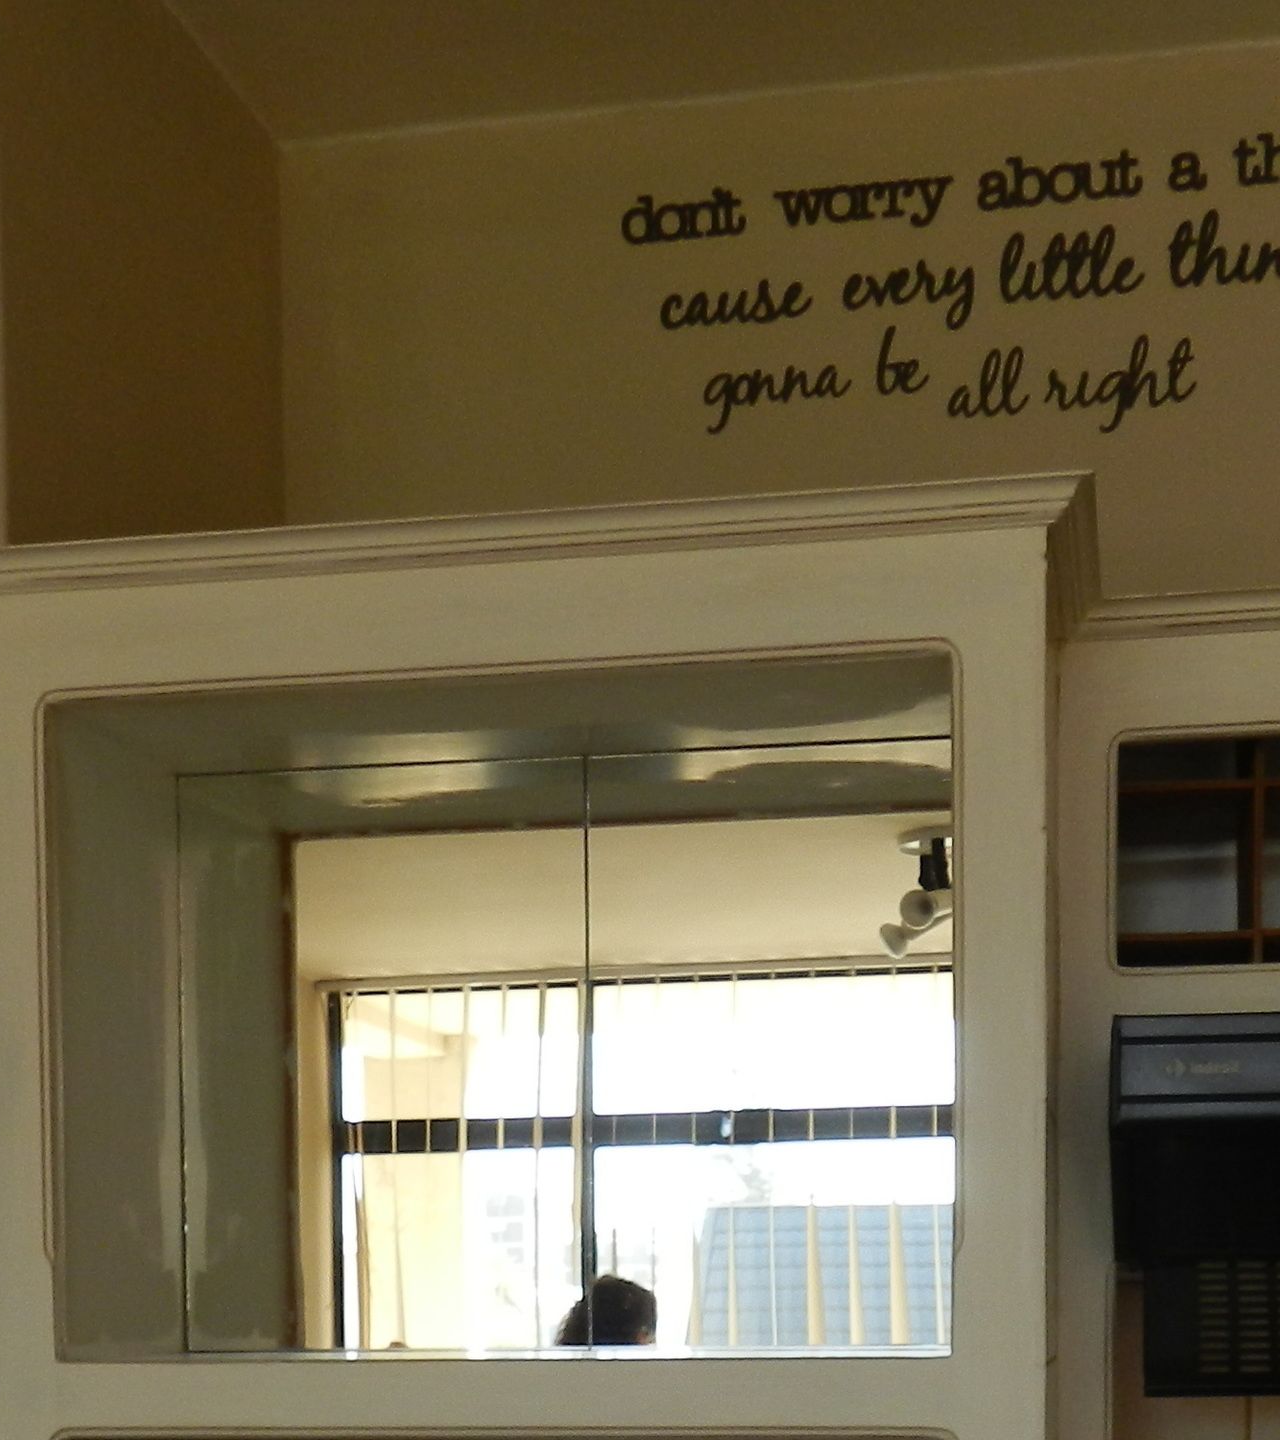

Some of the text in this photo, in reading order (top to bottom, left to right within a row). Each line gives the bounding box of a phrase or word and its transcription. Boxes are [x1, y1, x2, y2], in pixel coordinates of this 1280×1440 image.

[773, 175, 954, 228] worry
[977, 149, 1143, 212] about
[1168, 152, 1207, 192] a
[660, 279, 813, 330] cause
[842, 259, 975, 331] every
[999, 224, 1145, 304] little
[703, 325, 1197, 434] gonna be all right
